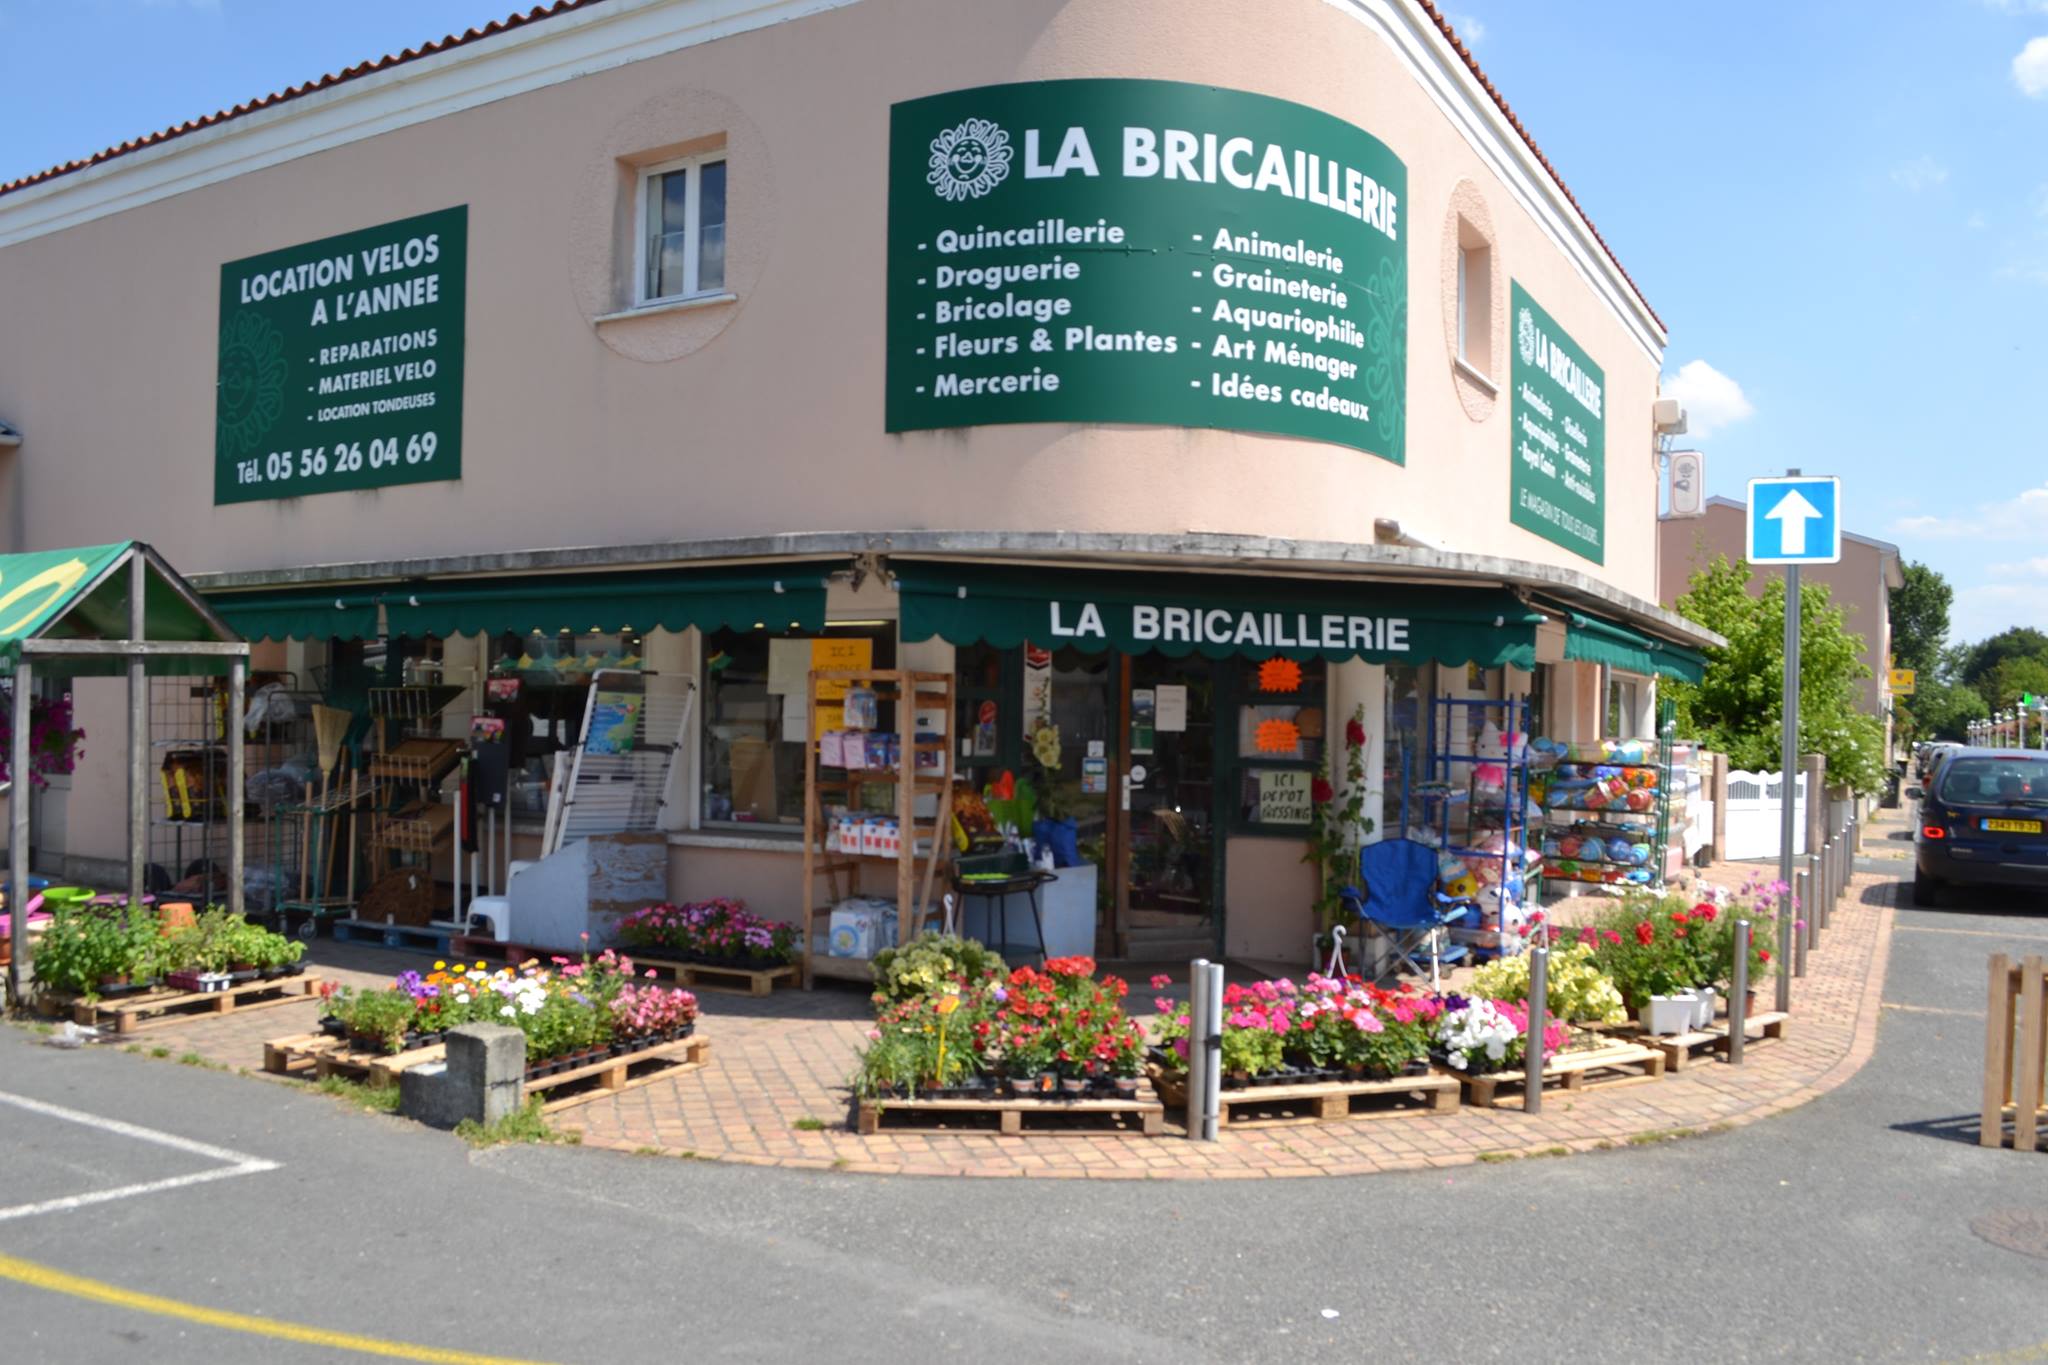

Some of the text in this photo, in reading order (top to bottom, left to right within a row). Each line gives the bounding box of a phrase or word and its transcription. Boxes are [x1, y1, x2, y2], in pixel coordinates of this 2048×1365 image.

[1024, 126, 1398, 242] LA BRICAILLERIE
[936, 219, 1125, 254] Quincaillerie
[1213, 228, 1344, 274] Animalerie
[241, 234, 439, 304] LOCATION VELOS
[936, 256, 1080, 291] Droguerie
[1212, 264, 1348, 310] Graineterie
[311, 274, 439, 326] A L'ANNEE
[936, 293, 1072, 324] Bricolage
[320, 328, 438, 366] REPARATIONS
[936, 326, 1178, 359] Fleurs & Plantes
[1212, 299, 1364, 350] Aquariophilie
[319, 359, 437, 395] MATERIEL VELO
[1212, 335, 1358, 382] Art Ménager
[1536, 328, 1601, 420] LA BRICAILLERIE
[934, 367, 1060, 398] Mercerie
[1212, 373, 1370, 423] Idées cadeaux
[318, 392, 436, 422] LOCATION TONDEUSES
[237, 431, 438, 484] Tél. 05 56 26 04 69
[1050, 601, 1410, 652] LA BRICAILLERIE
[1274, 773, 1294, 786] ICI
